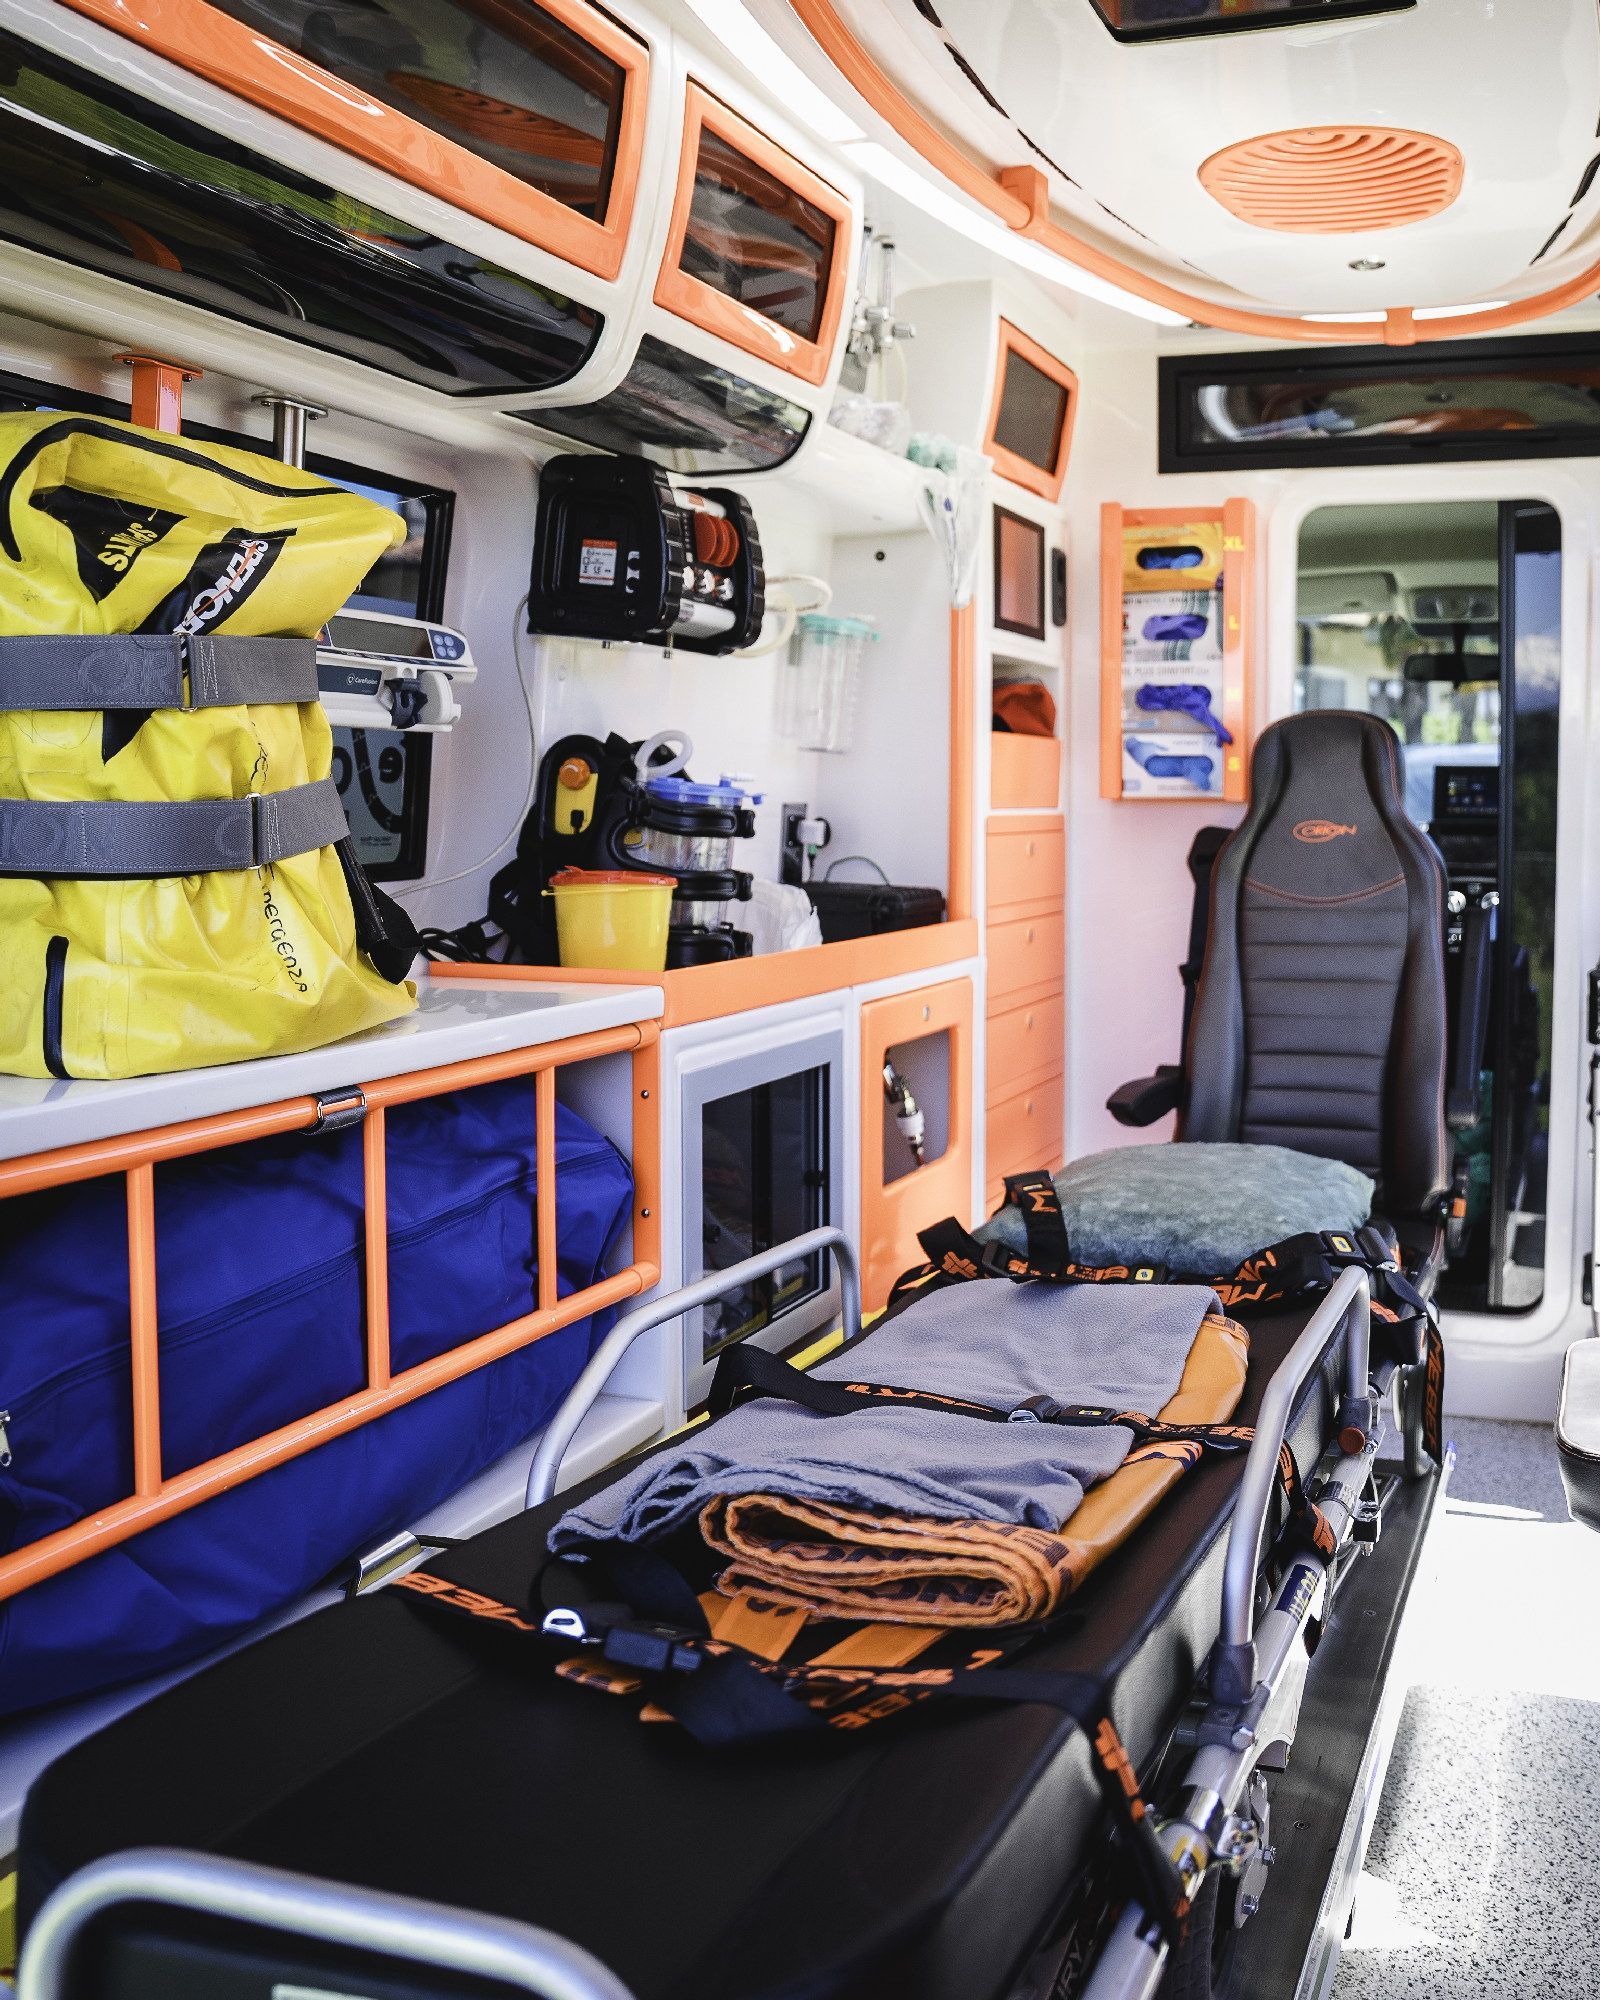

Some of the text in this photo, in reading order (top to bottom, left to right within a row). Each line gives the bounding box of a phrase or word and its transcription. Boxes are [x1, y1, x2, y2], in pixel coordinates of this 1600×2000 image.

[1223, 536, 1245, 551] XL
[172, 539, 269, 636] SPENCE
[1229, 614, 1239, 630] L
[1228, 757, 1240, 772] S
